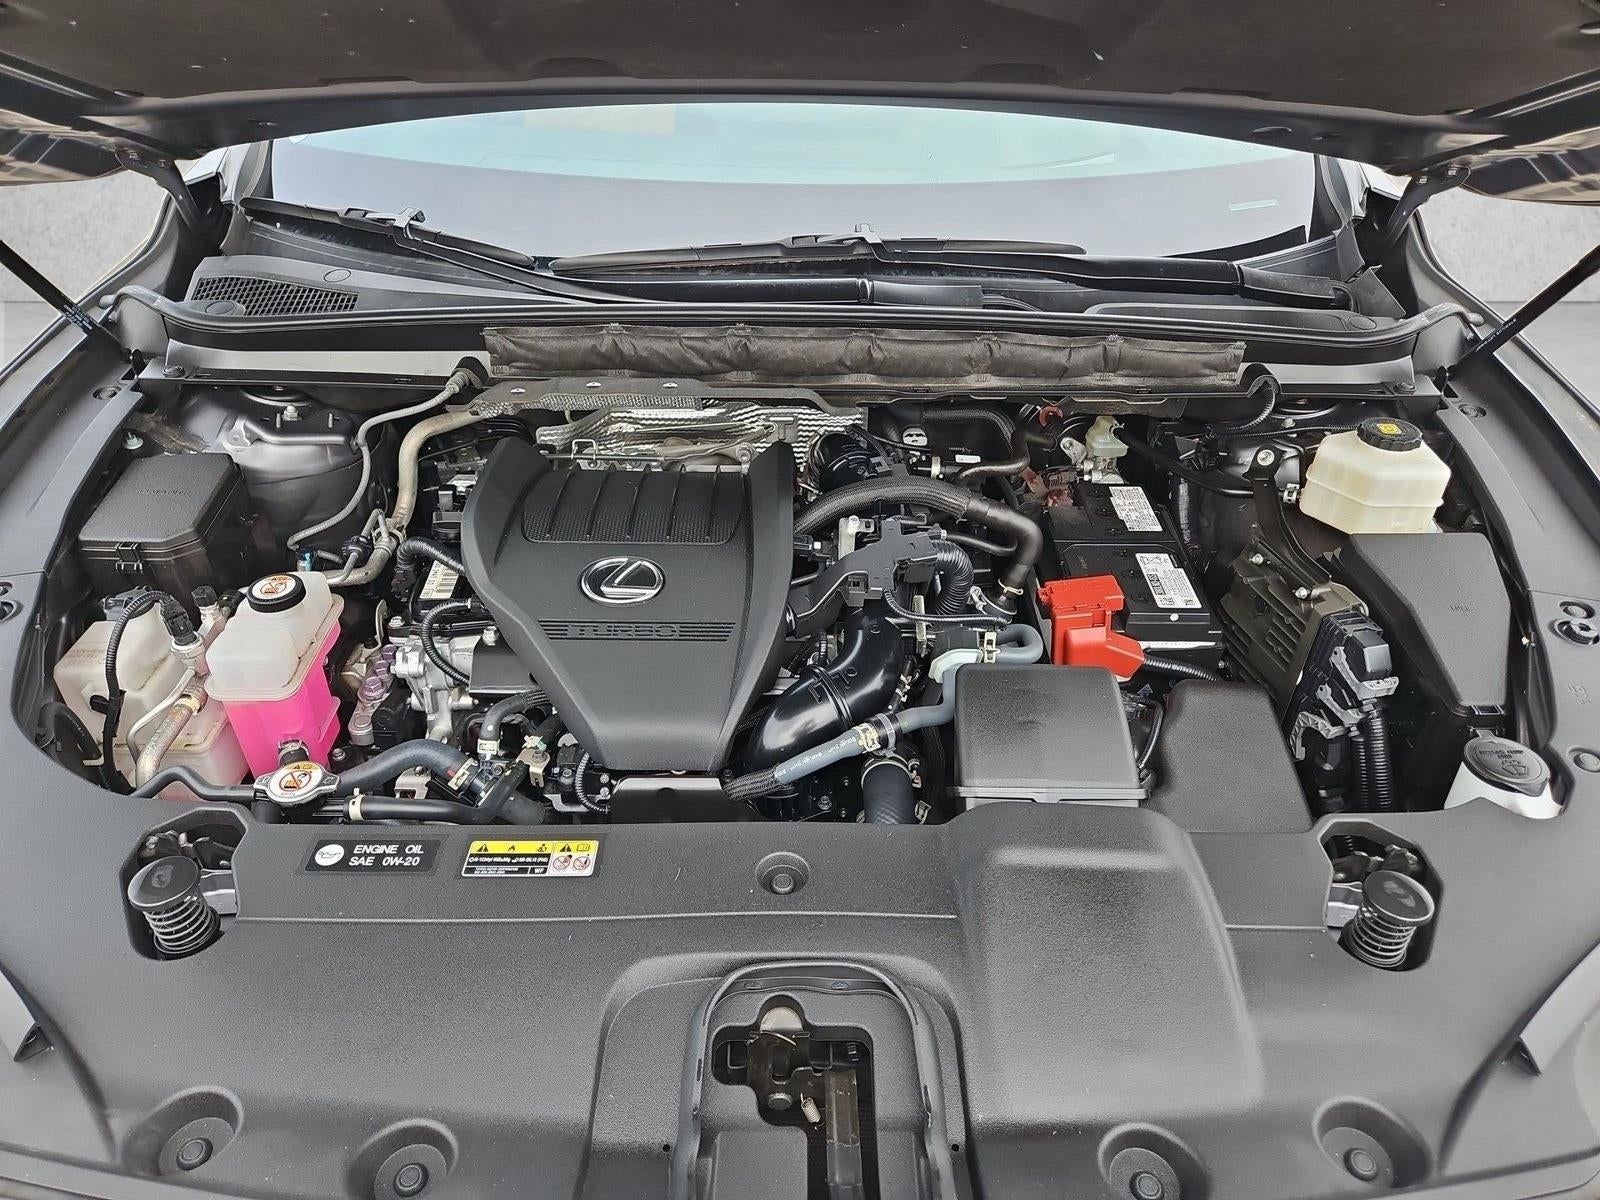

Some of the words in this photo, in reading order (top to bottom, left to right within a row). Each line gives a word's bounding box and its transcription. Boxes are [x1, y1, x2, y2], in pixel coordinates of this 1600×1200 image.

[568, 623, 680, 639] TURBO
[353, 844, 399, 854] ENGINE
[405, 844, 424, 854] OIL
[348, 856, 375, 866] SAE
[382, 856, 420, 866] 0W-20
